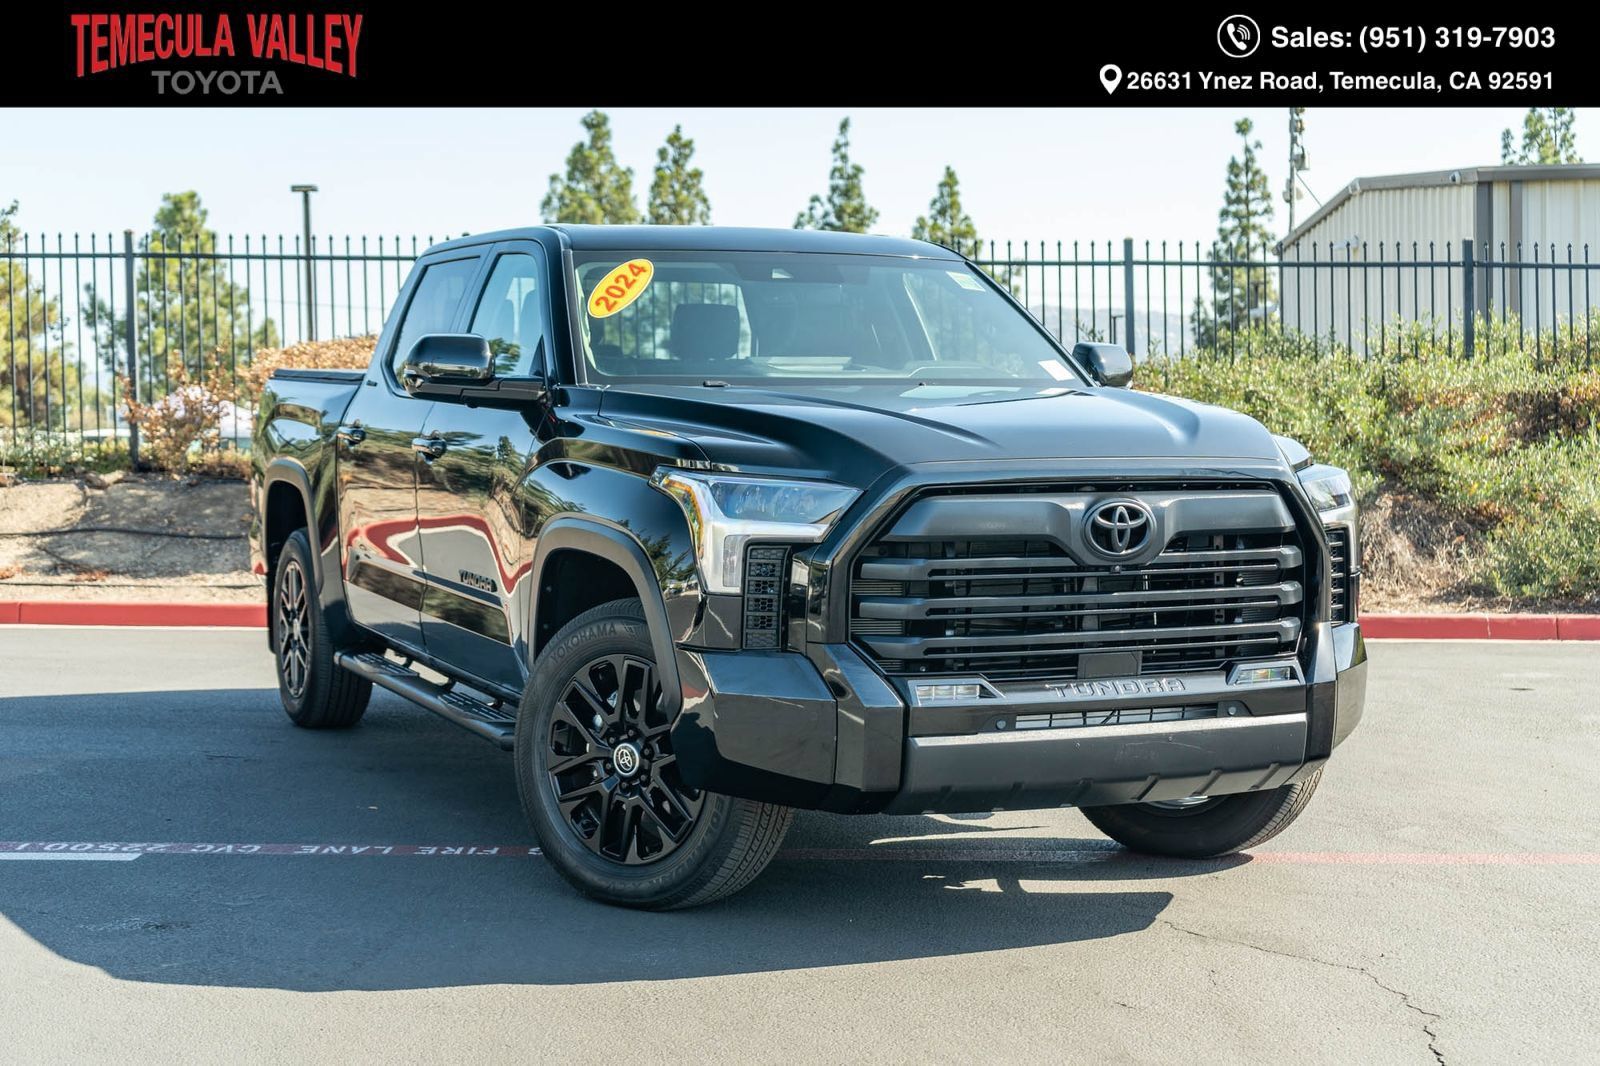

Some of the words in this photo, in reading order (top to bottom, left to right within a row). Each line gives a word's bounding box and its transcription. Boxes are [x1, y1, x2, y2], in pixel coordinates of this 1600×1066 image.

[595, 263, 648, 312] 2024
[459, 569, 498, 592] TUNDRA
[550, 622, 617, 663] YOKOHAMA
[1045, 677, 1186, 698] TUNDRA
[294, 845, 394, 855] LANE
[414, 846, 499, 855] FIRE
